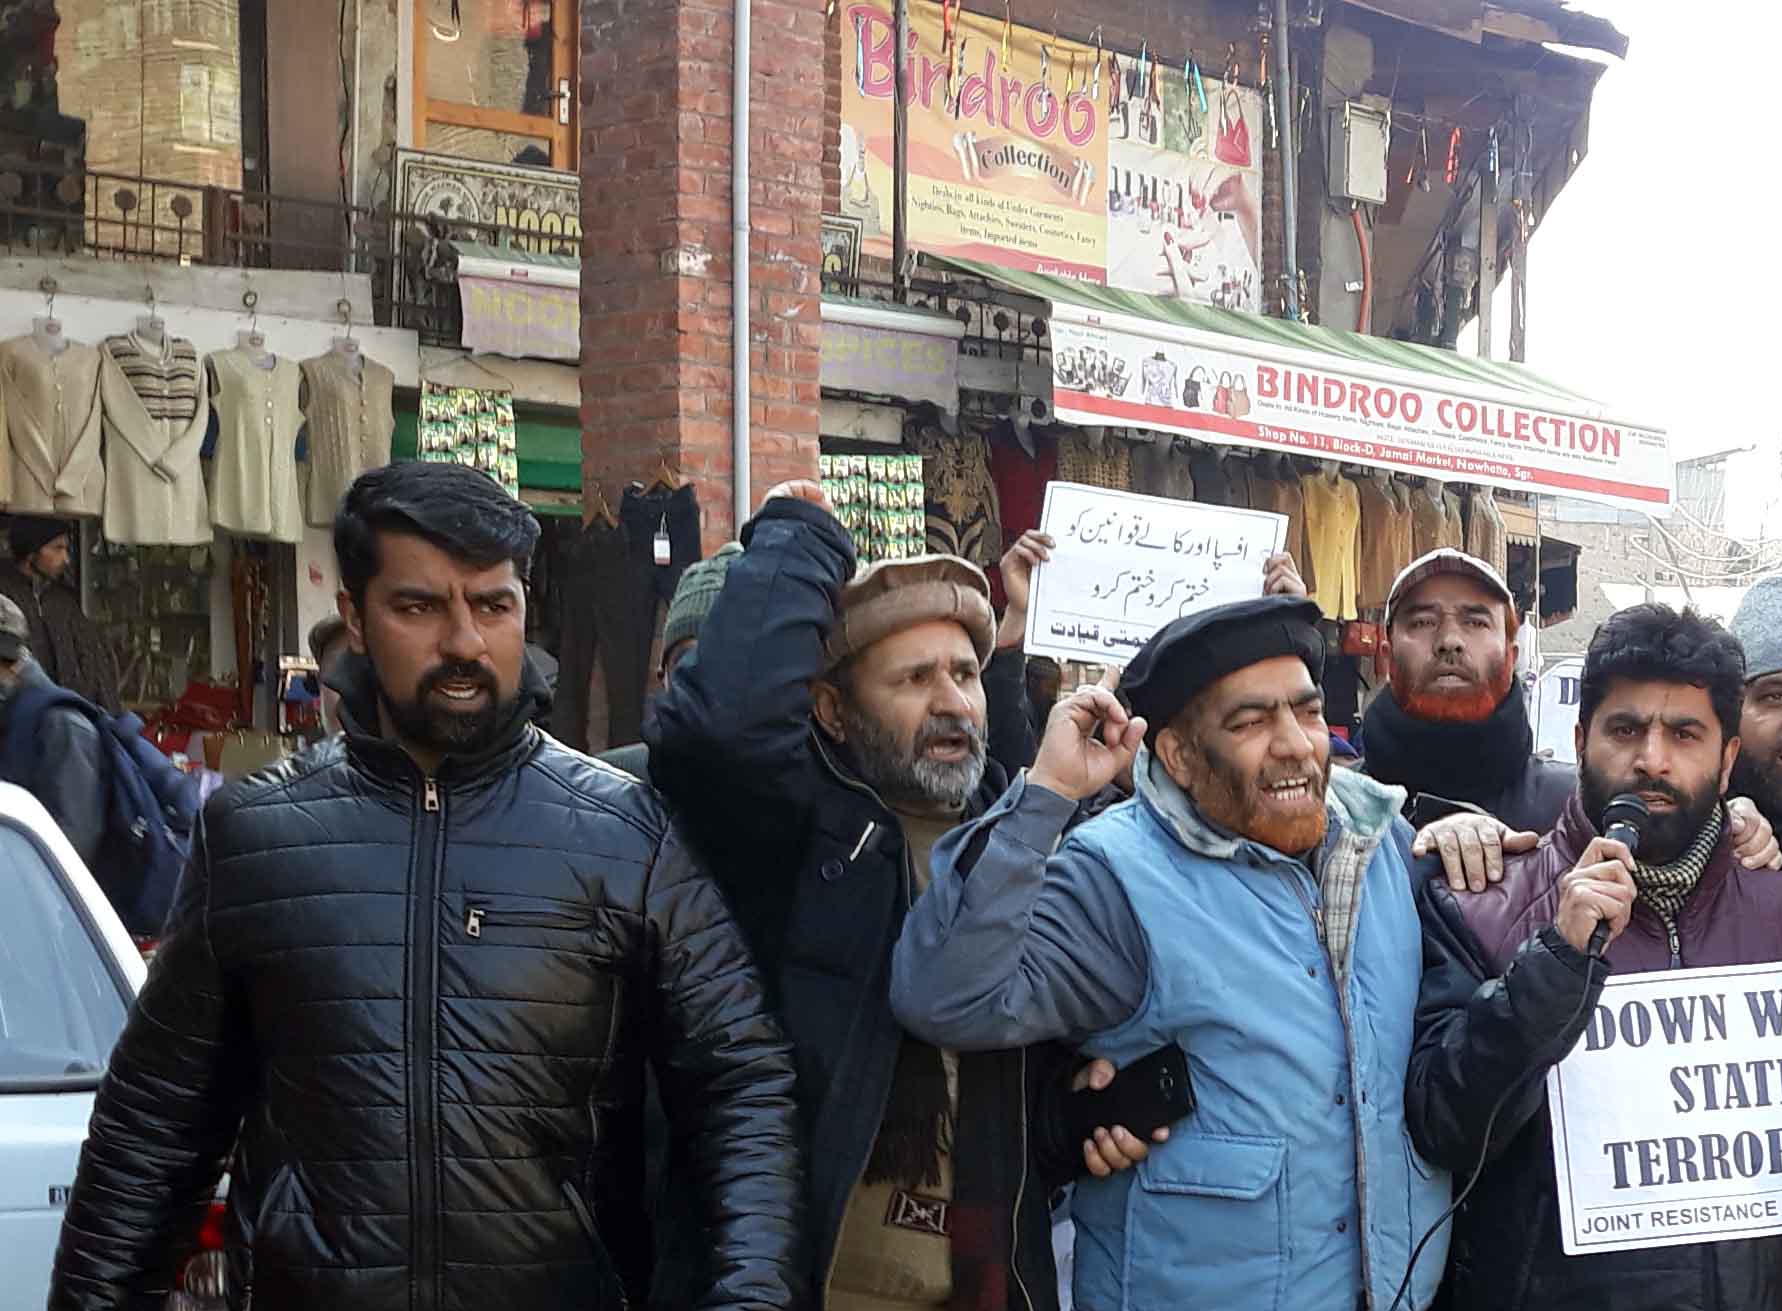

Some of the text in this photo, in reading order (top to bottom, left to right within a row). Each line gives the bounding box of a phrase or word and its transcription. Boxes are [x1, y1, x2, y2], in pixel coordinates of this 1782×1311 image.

[848, 5, 1096, 146] Bindroo
[981, 145, 1070, 188] Collection
[1256, 364, 1423, 424] BINDROO
[1437, 399, 1621, 458] COLLECTION
[1257, 424, 1287, 443] Shop
[1290, 431, 1309, 445] No.
[1416, 449, 1454, 469] Market,
[1584, 993, 1728, 1052] DOWN
[1582, 1212, 1644, 1236] JOINT
[1651, 1199, 1778, 1228] RESISTANCE
